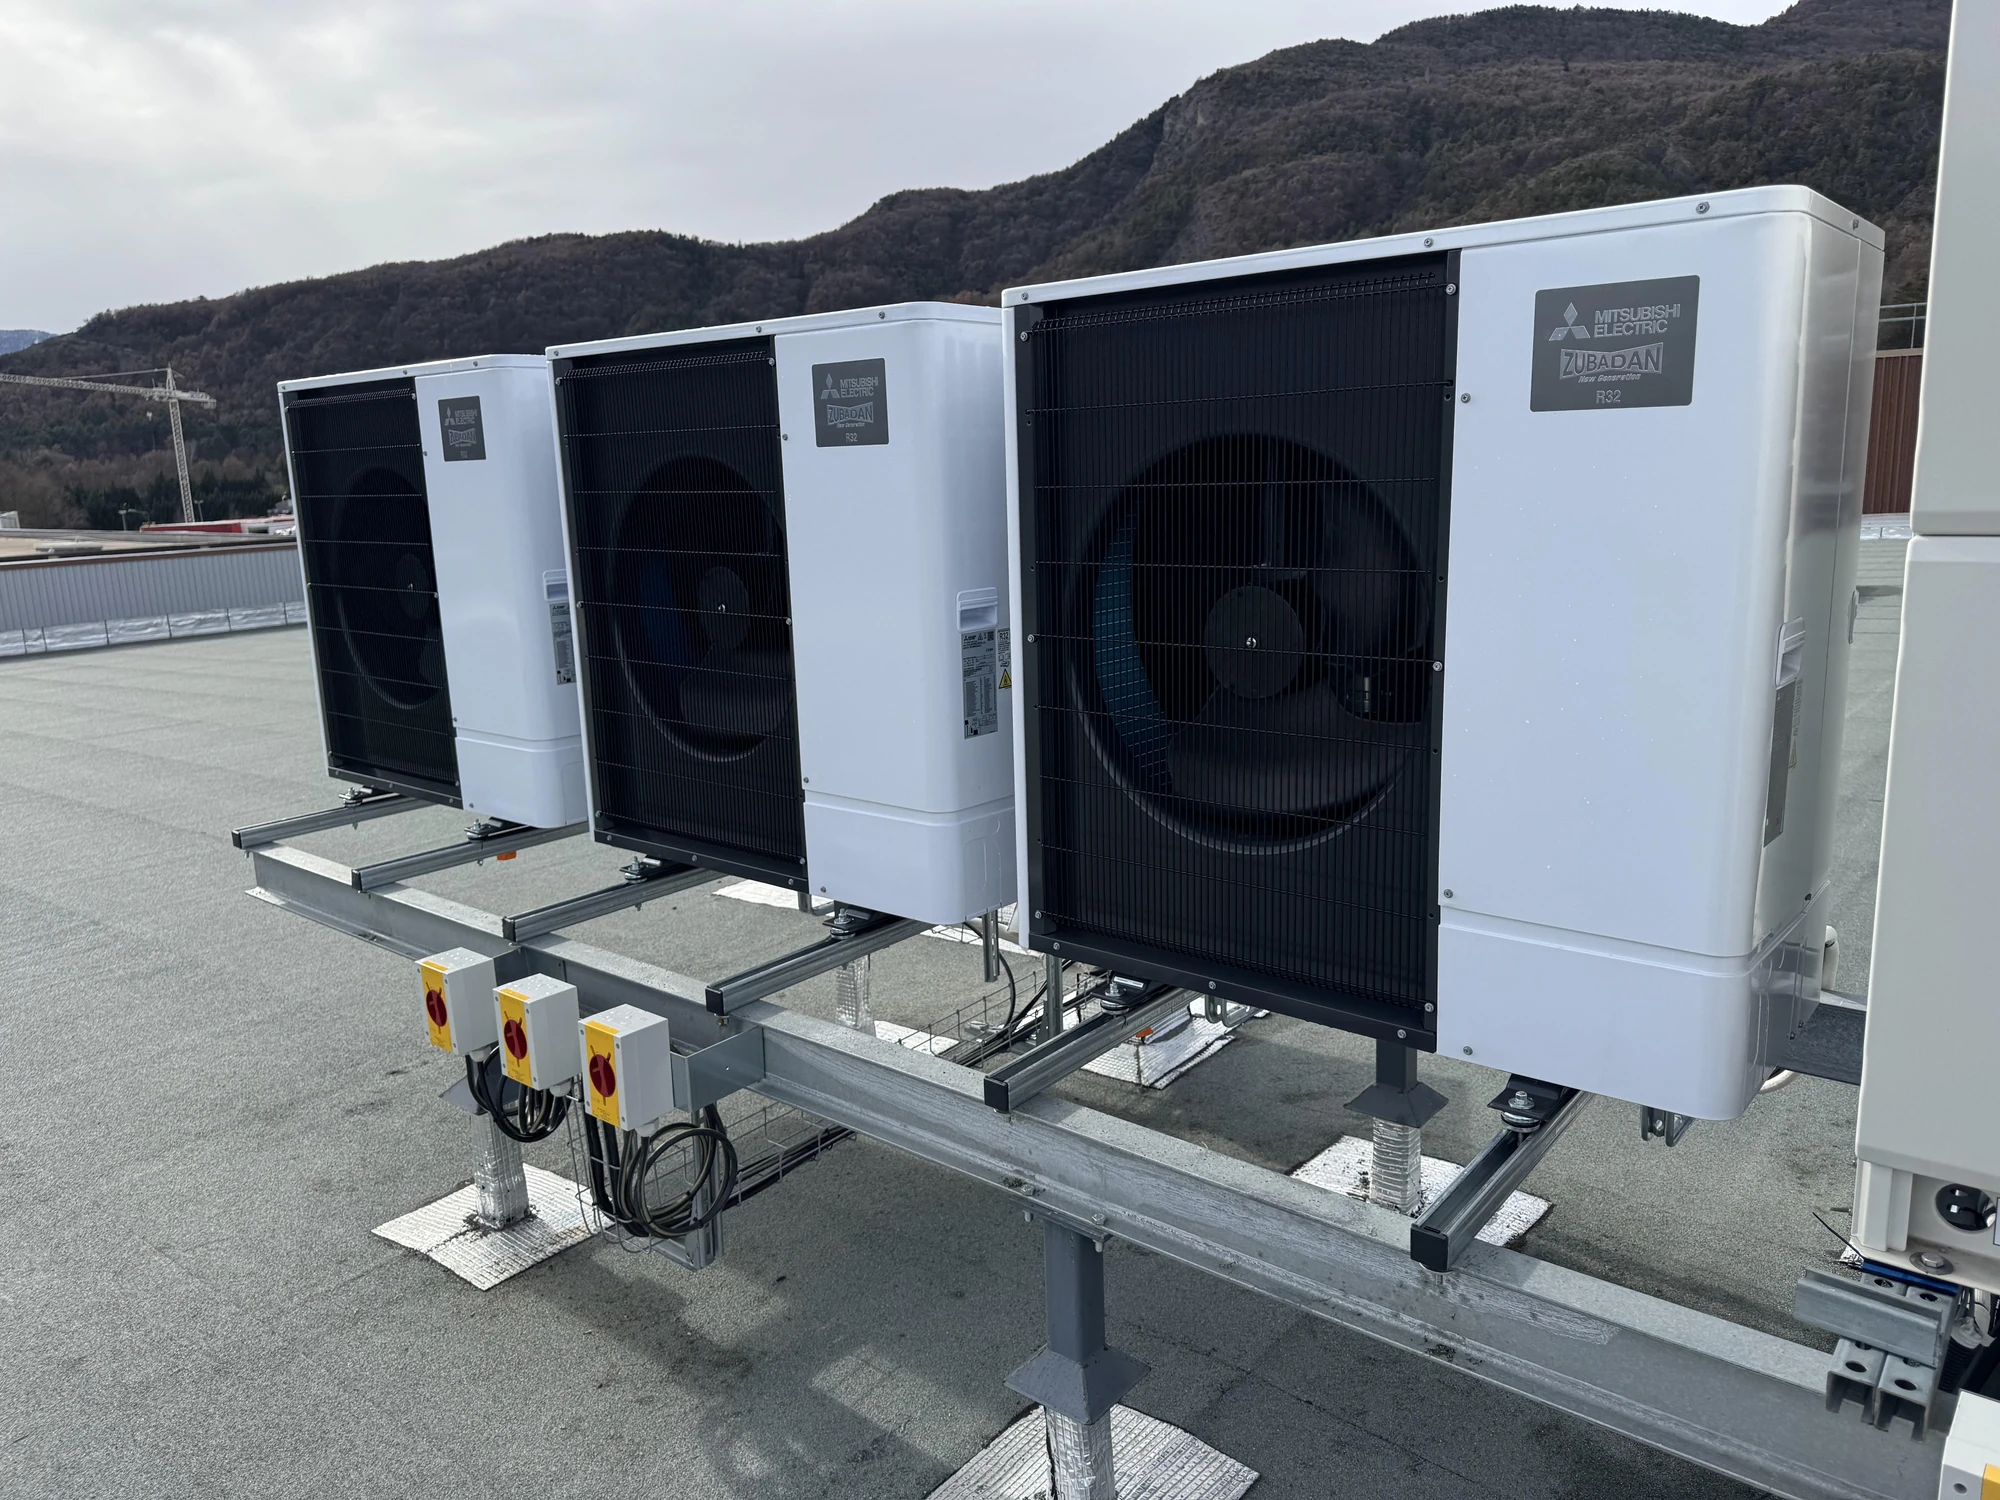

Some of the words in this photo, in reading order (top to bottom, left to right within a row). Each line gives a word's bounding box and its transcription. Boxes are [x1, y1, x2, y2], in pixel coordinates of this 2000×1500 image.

[1594, 303, 1681, 324] MITSUBISHI
[1593, 319, 1668, 338] ELECTRIC
[1561, 345, 1662, 378] ZUBADAN
[840, 376, 879, 389] MITSUBISHI
[1577, 374, 1597, 384] New
[1597, 373, 1642, 382] Generation
[840, 387, 874, 398] ELECTRIC
[1595, 389, 1622, 404] R32
[827, 403, 873, 424] ZUBADAN
[845, 432, 858, 442] R32
